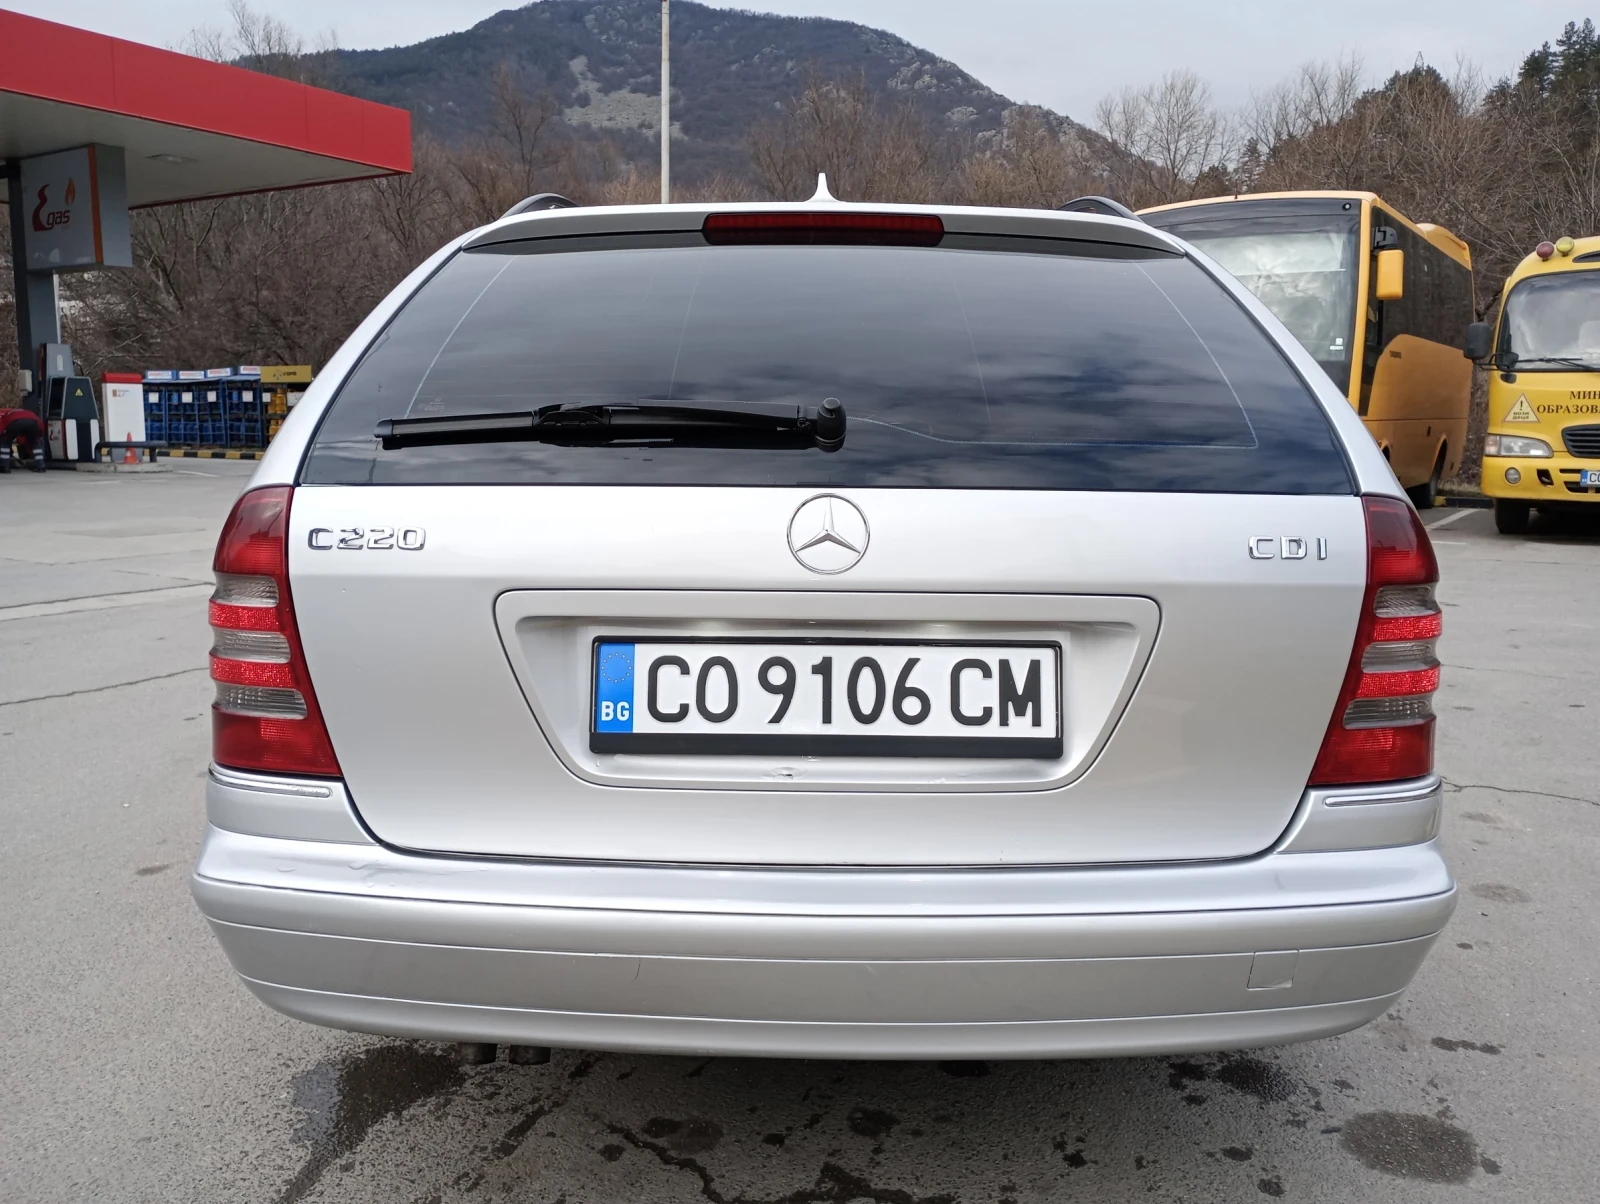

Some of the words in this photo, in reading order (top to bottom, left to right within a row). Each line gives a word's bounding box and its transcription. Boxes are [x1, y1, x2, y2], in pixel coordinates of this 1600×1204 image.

[1536, 404, 1600, 414] ОБРАЗОВ
[307, 526, 426, 551] C220
[1247, 535, 1328, 560] CDI
[647, 655, 739, 724] CO
[757, 656, 931, 726] 9106
[949, 658, 1042, 728] CM
[601, 701, 630, 721] BG
